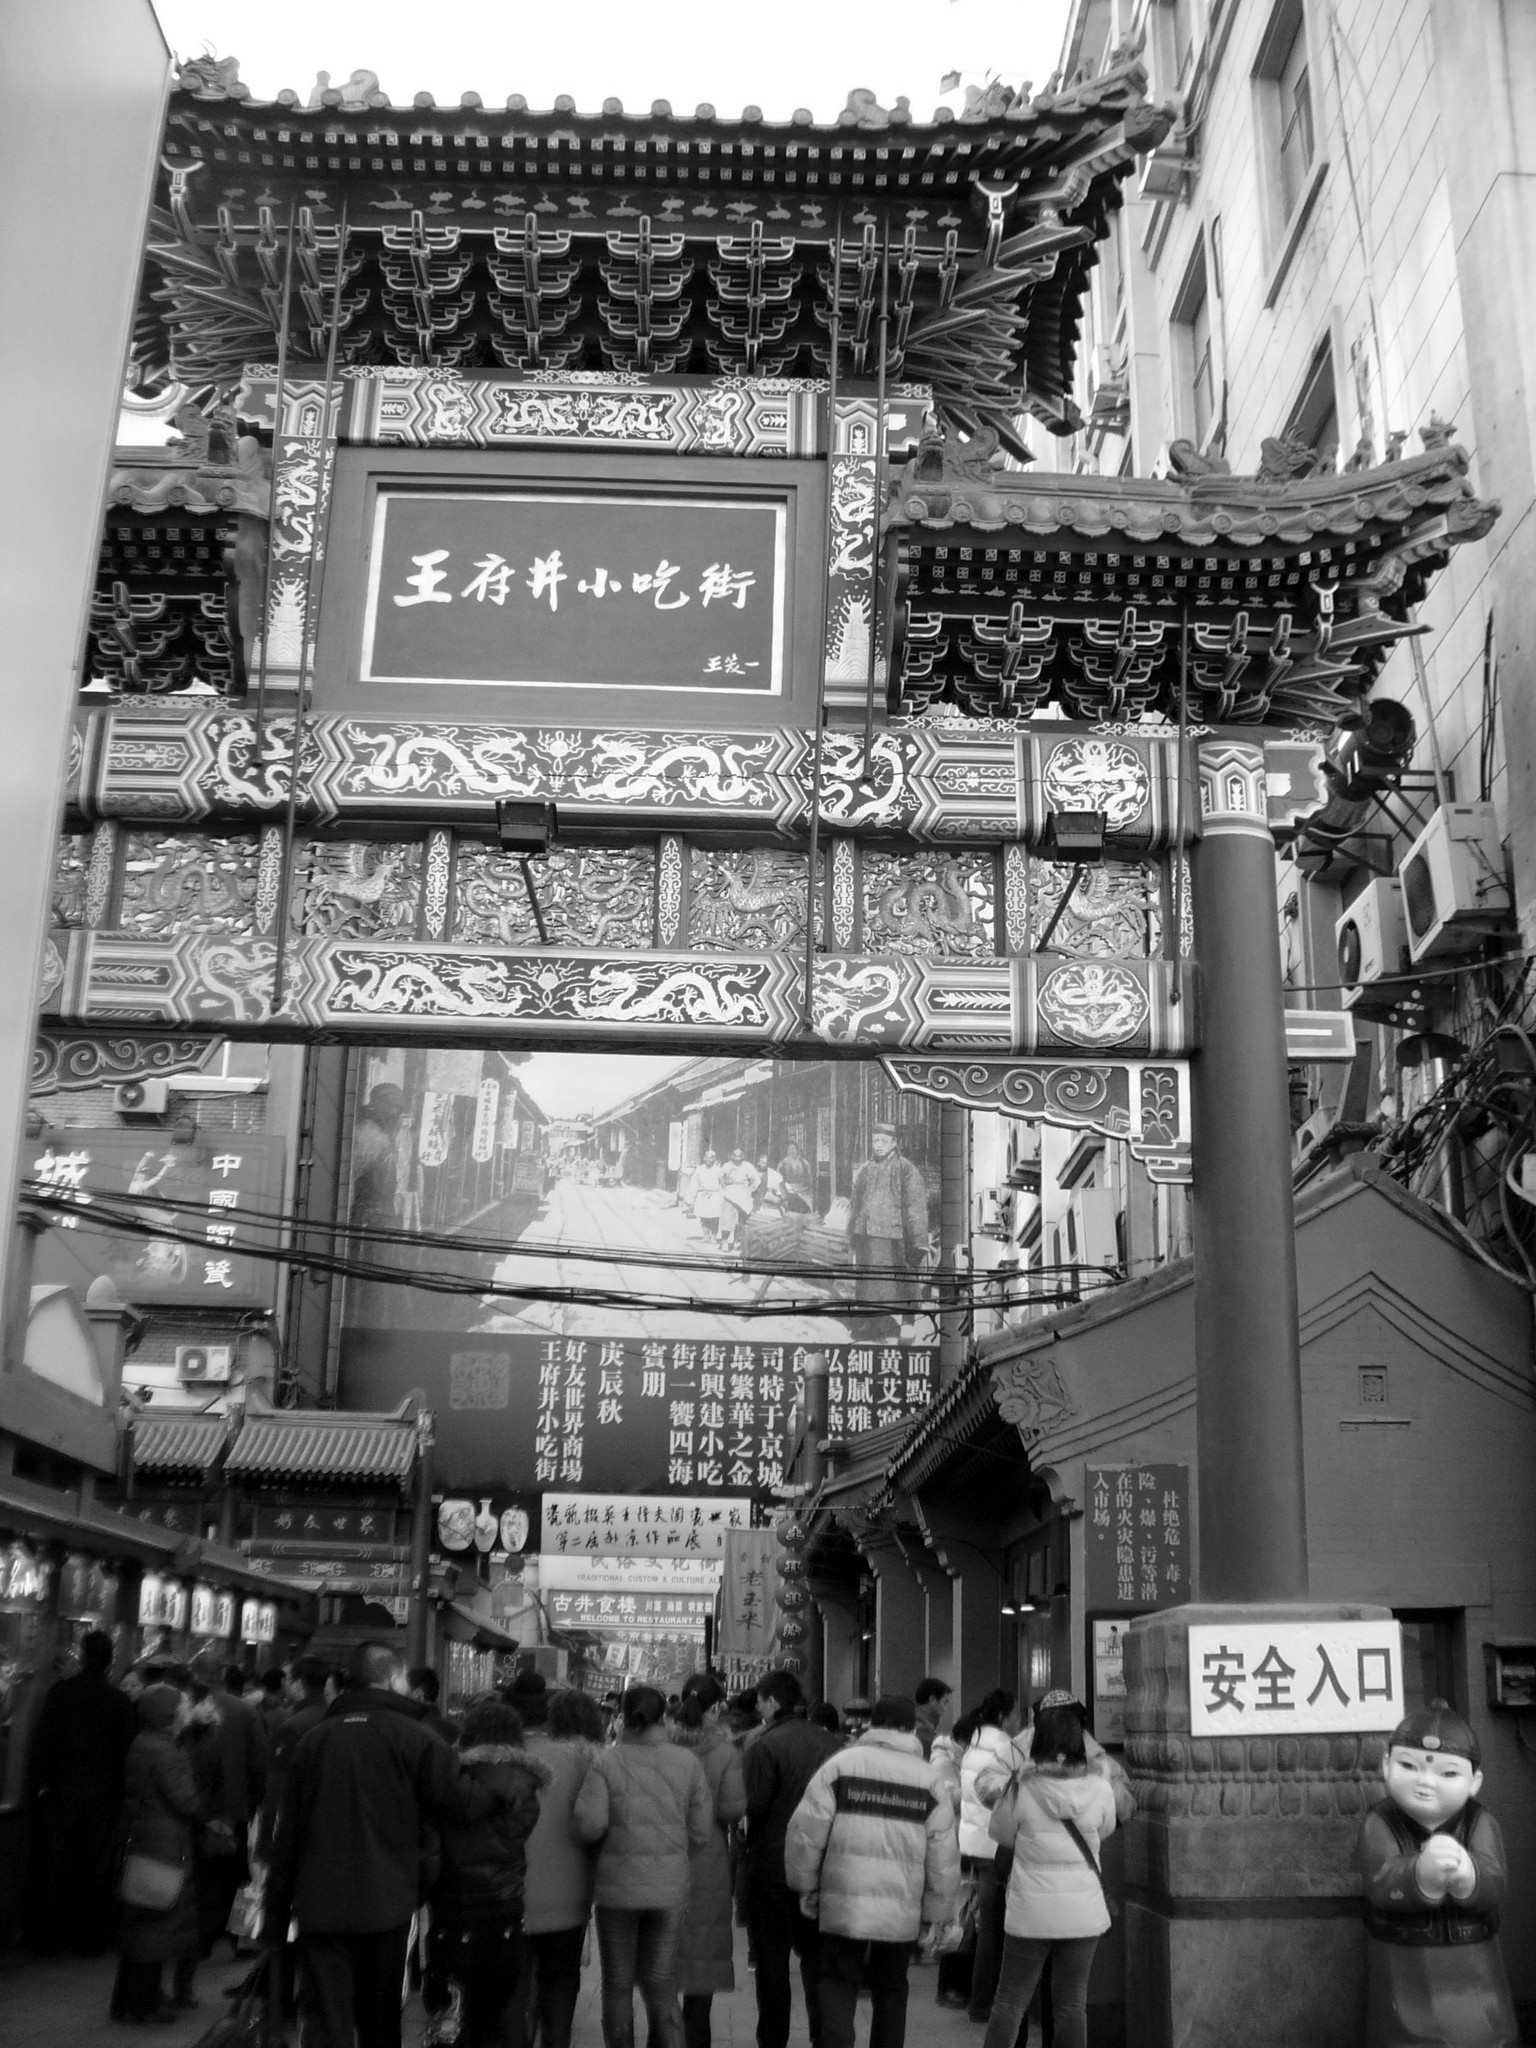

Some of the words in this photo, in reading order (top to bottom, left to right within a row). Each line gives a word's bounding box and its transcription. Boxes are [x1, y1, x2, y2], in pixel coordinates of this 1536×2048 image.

[393, 549, 756, 612] 王府井小吃街
[535, 1340, 561, 1482] 王府井小吃街
[560, 1339, 588, 1483] 好友世界商場
[597, 1341, 624, 1425] 庚辰秋
[640, 1342, 668, 1398] 賓朋
[668, 1343, 697, 1486] 街一饗四海
[698, 1344, 726, 1486] 街興建小吃
[727, 1345, 756, 1486] 最繁華之金
[757, 1346, 785, 1488] 司特于京城
[1116, 1472, 1134, 1600] 在的火灾隐患进
[553, 1593, 637, 1614] 古井食楼
[577, 1574, 623, 1583] TRADITIONAL
[628, 1575, 658, 1583] CUSTOM
[671, 1576, 705, 1584] CULTURE
[580, 1614, 620, 1623] WELCOME
[623, 1615, 634, 1624] TO
[637, 1616, 693, 1625] RESTAURANT
[736, 1570, 764, 1630] 老玉米
[1202, 1643, 1393, 1714] 安全入口
